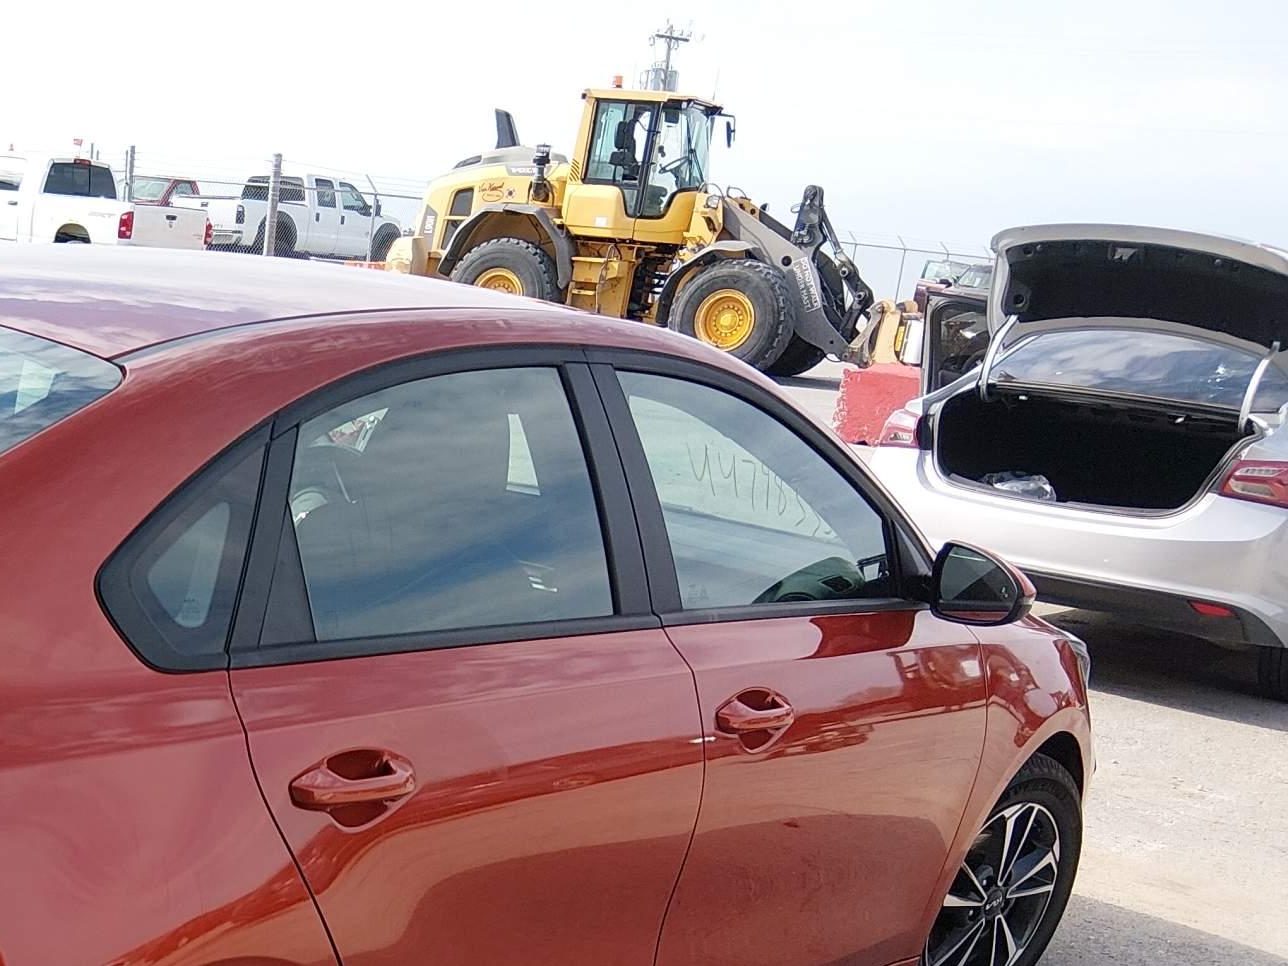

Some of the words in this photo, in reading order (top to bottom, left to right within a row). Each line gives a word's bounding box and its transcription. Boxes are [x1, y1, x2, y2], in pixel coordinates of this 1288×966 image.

[793, 262, 805, 290] UNDER
[800, 290, 811, 309] MAST
[800, 257, 809, 270] DO
[808, 286, 819, 308] WALK
